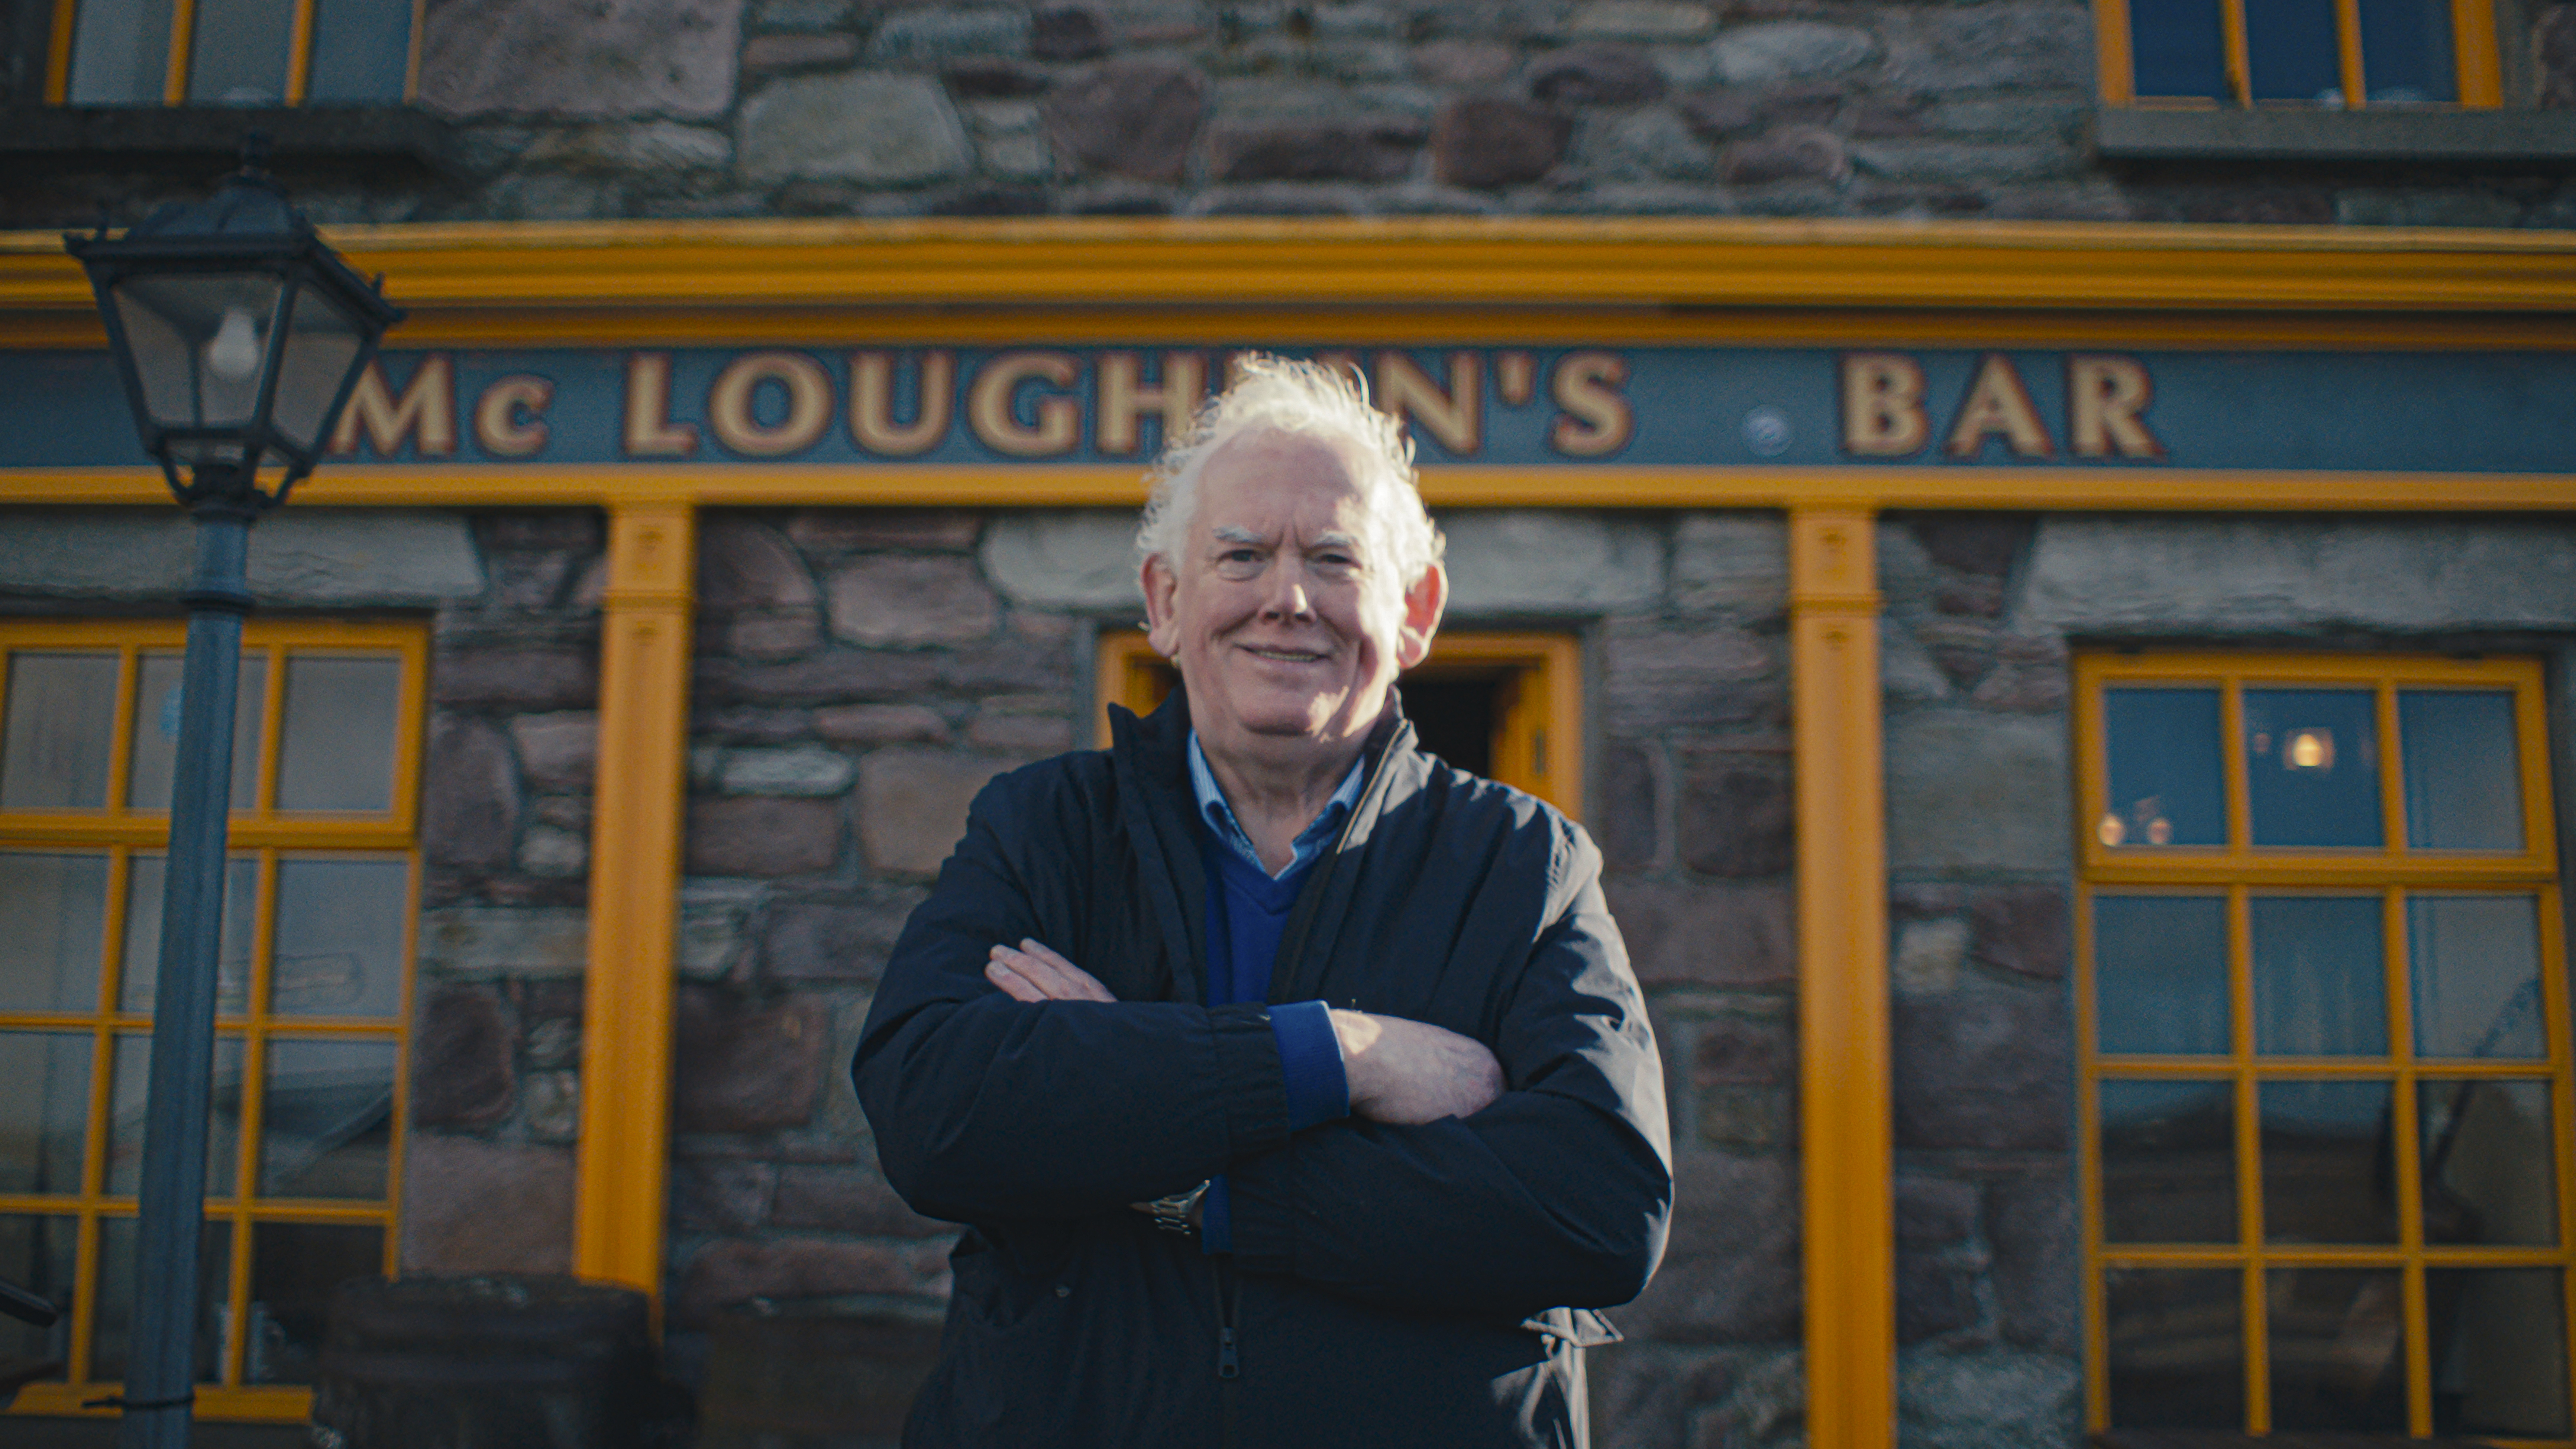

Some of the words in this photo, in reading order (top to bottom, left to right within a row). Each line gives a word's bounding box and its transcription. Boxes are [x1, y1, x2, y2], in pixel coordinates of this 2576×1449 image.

[330, 353, 553, 458] Mc
[624, 350, 1633, 458] LOUGHN'S
[1838, 352, 2163, 460] BAR
